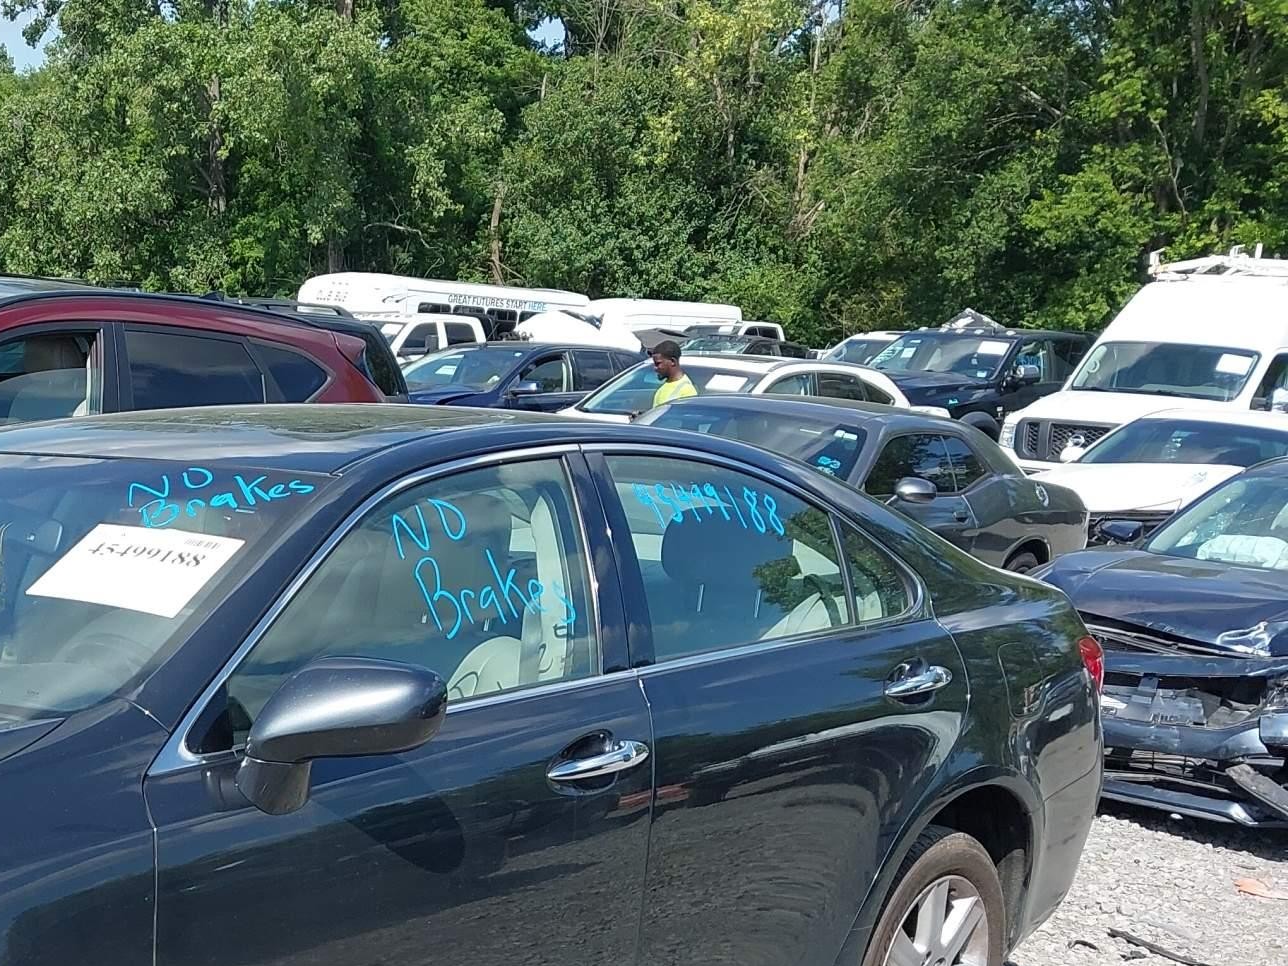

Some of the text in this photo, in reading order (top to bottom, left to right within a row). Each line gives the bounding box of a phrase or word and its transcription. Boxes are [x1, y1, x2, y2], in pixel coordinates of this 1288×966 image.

[448, 294, 547, 312] GREAT FUTURES START HERE
[138, 475, 315, 528] Brakes
[88, 541, 207, 568] 45499188
